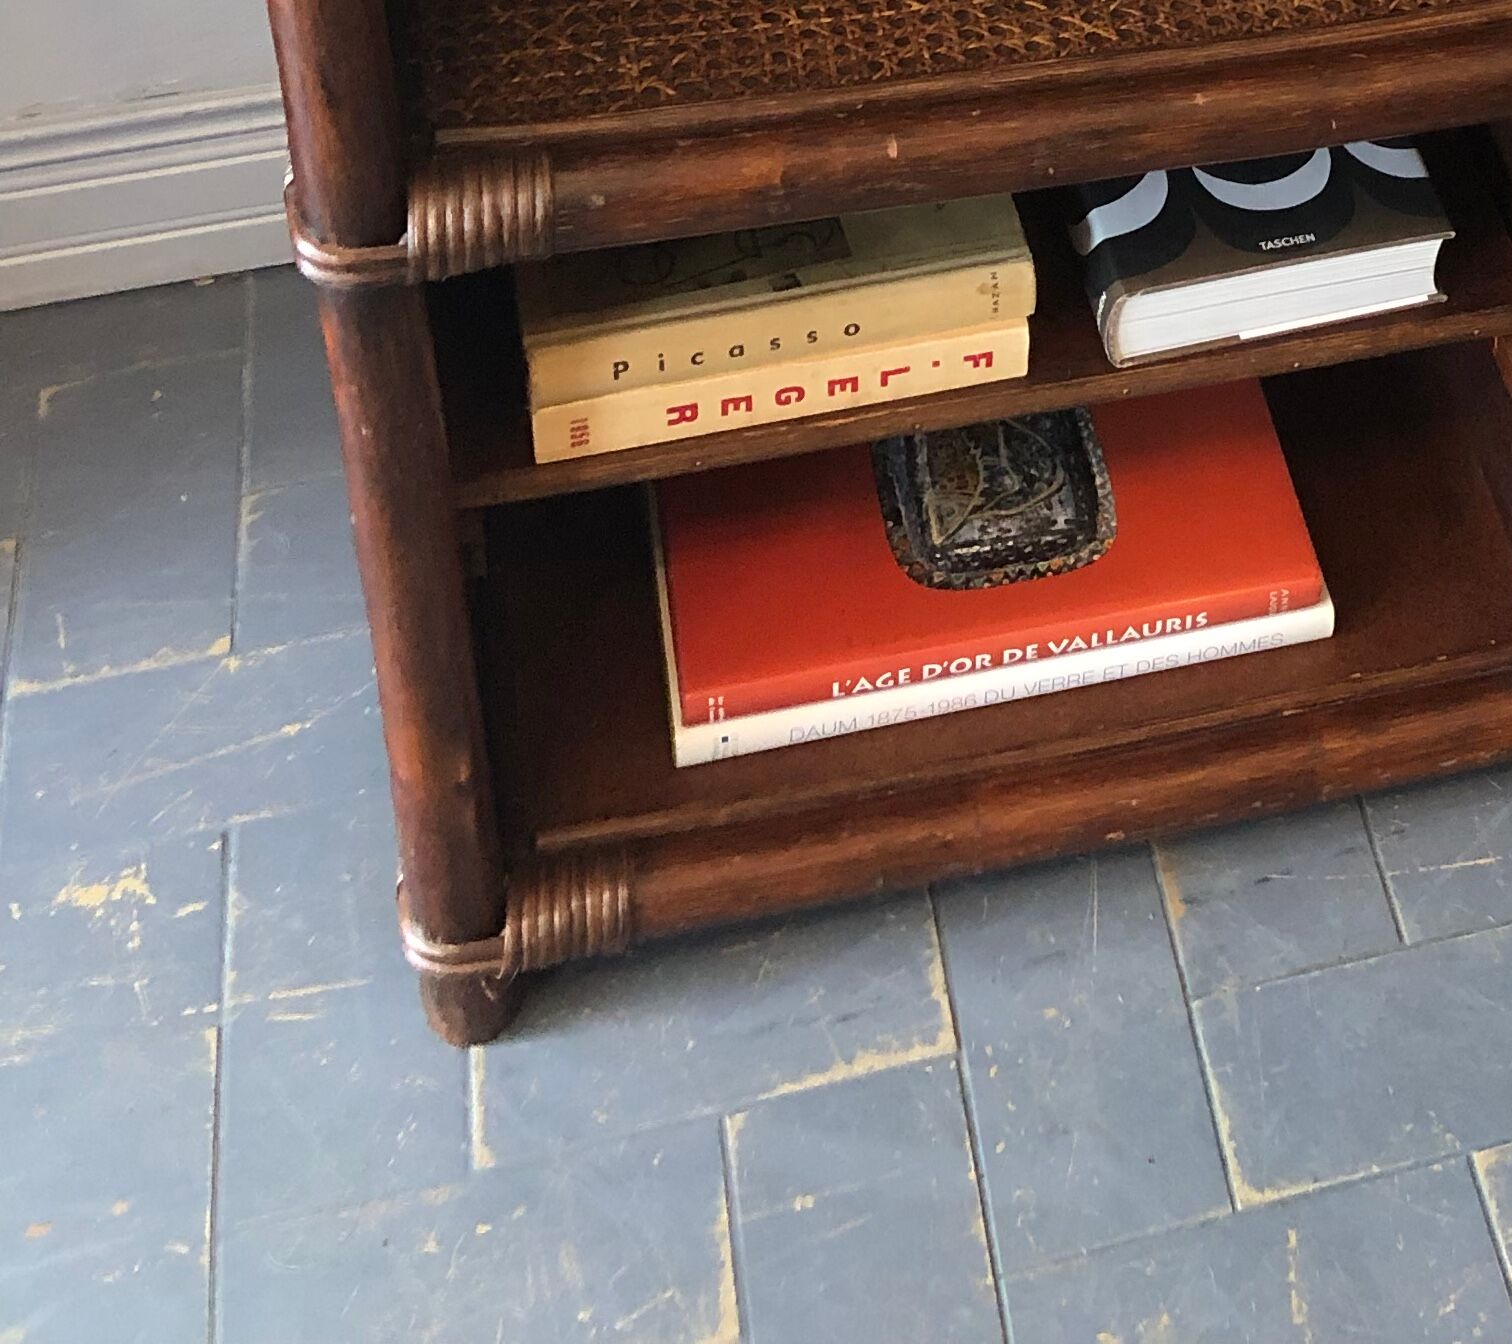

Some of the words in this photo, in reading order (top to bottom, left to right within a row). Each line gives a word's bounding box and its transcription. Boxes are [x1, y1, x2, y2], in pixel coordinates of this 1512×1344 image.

[1259, 233, 1316, 250] TASCHEN
[612, 322, 861, 380] Picasso
[789, 717, 858, 743] DAUM
[984, 685, 1016, 704] DU
[1024, 669, 1096, 695] VERRE
[1103, 663, 1127, 681] ET
[1136, 654, 1179, 674] DES
[1187, 632, 1285, 662] HOMMES
[832, 667, 911, 697] L'AGE
[922, 653, 992, 681] D'OR
[1002, 644, 1039, 665] DE
[1048, 612, 1208, 654] VALLAURIS
